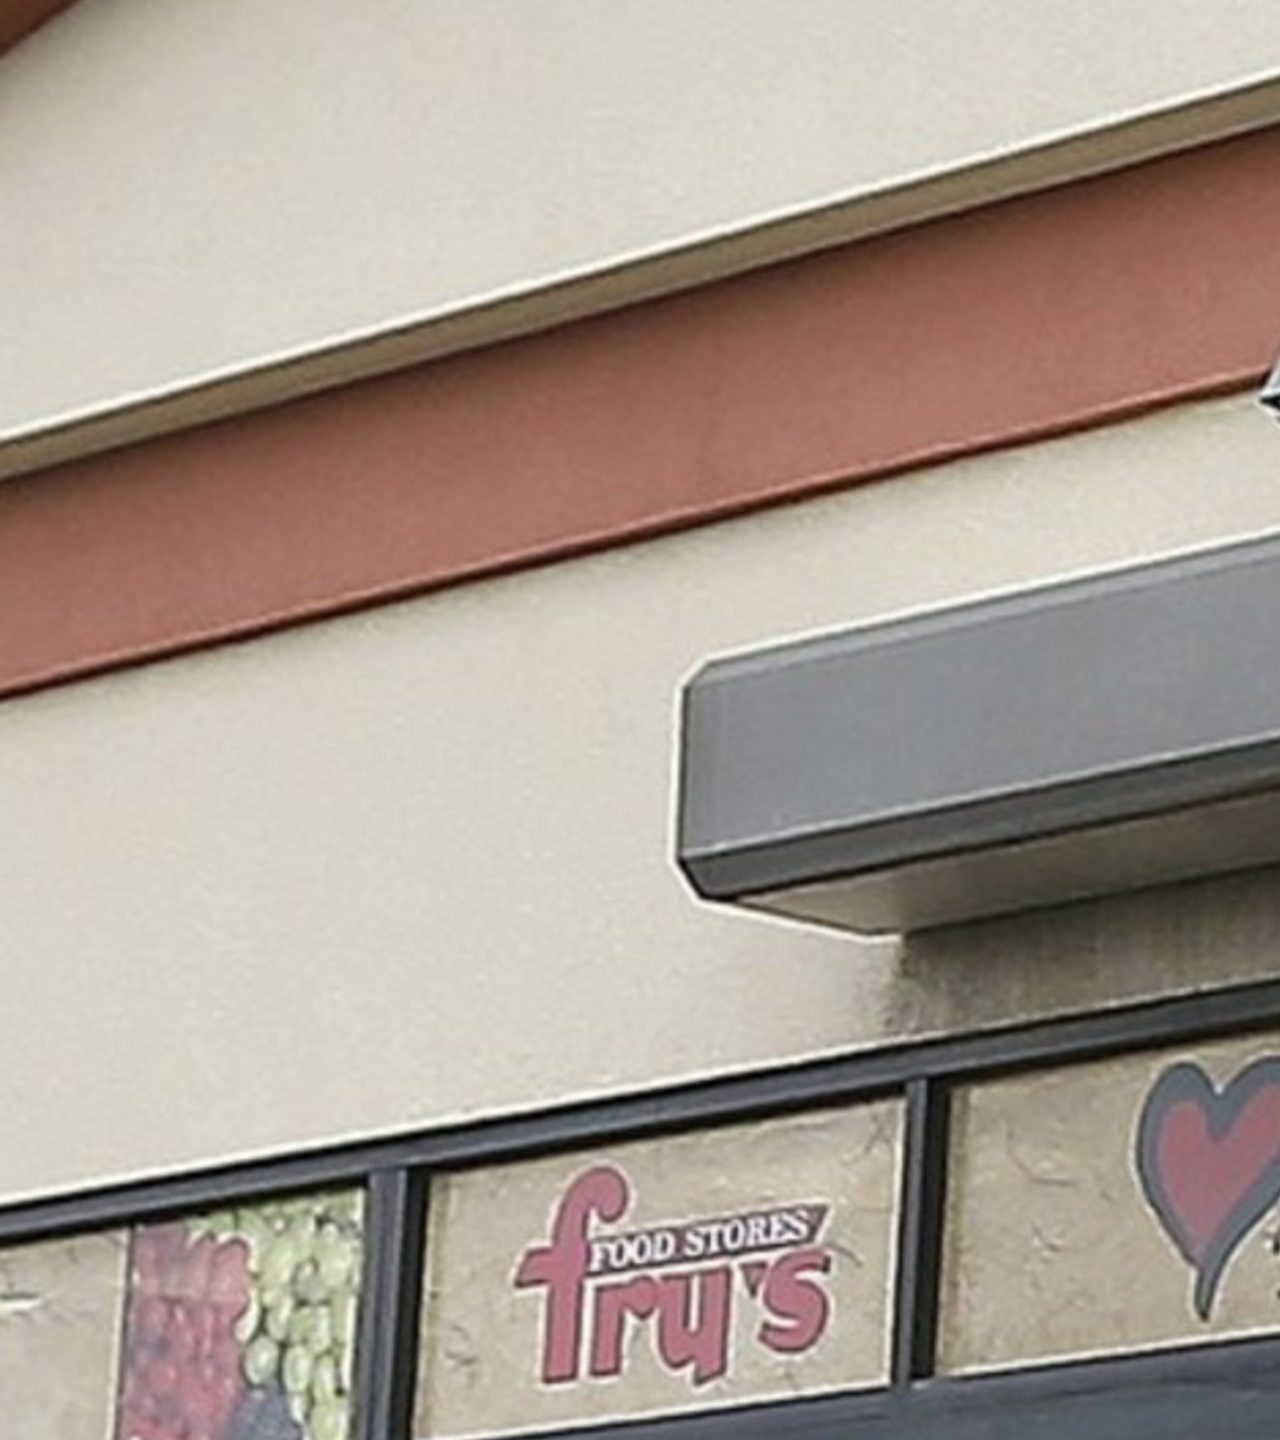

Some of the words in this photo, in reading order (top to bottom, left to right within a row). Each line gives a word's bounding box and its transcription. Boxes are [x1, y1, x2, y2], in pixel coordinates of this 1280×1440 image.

[512, 1164, 832, 1388] fry's
[590, 1229, 675, 1273] FOOD
[684, 1209, 812, 1258] STORES
